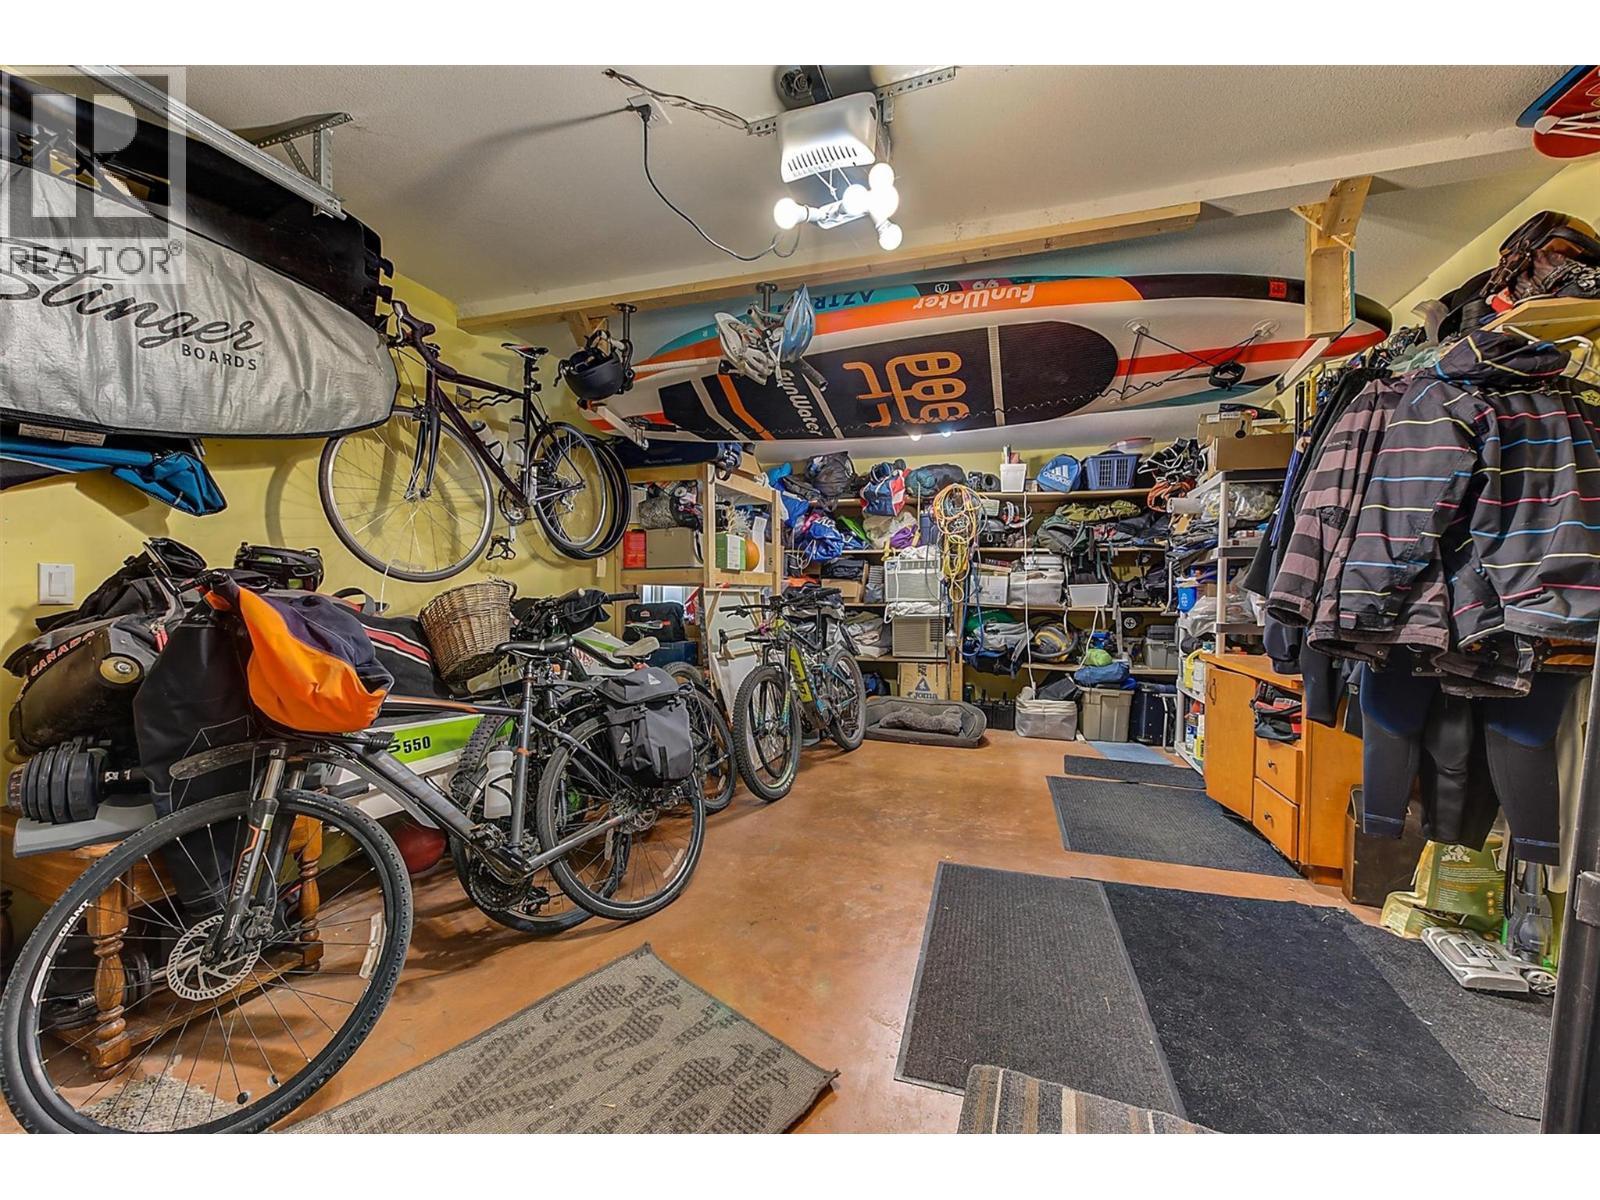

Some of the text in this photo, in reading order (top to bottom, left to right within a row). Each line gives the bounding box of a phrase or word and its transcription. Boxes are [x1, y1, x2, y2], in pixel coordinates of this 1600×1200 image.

[181, 343, 257, 371] BOARDS
[1043, 471, 1071, 486] adidas
[30, 630, 96, 677] CANADA
[402, 735, 431, 753] 550
[233, 852, 252, 899] GIANT
[59, 899, 89, 937] GIANT
